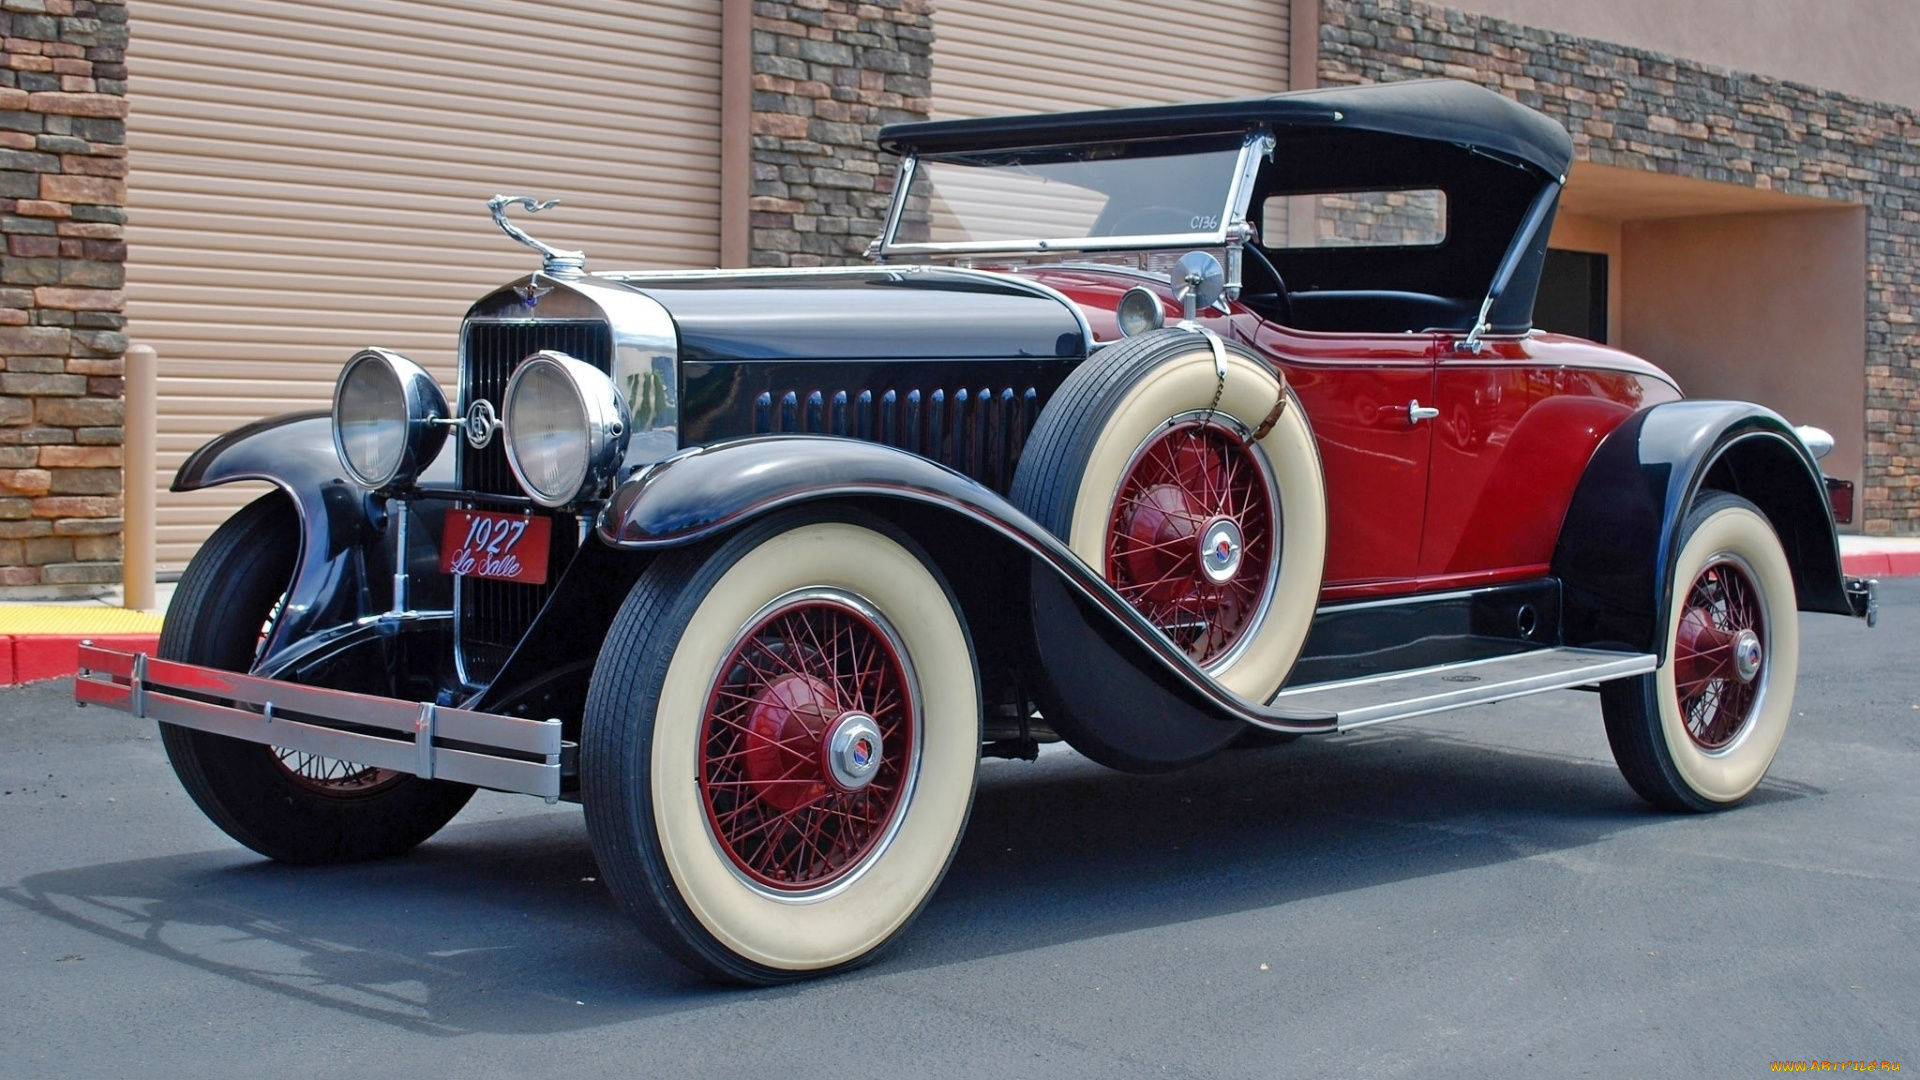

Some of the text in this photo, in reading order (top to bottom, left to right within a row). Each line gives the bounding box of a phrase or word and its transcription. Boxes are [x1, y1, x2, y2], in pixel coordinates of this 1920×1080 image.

[1190, 215, 1217, 229] C136
[464, 517, 525, 553] 1927
[450, 549, 523, 577] La Salle
